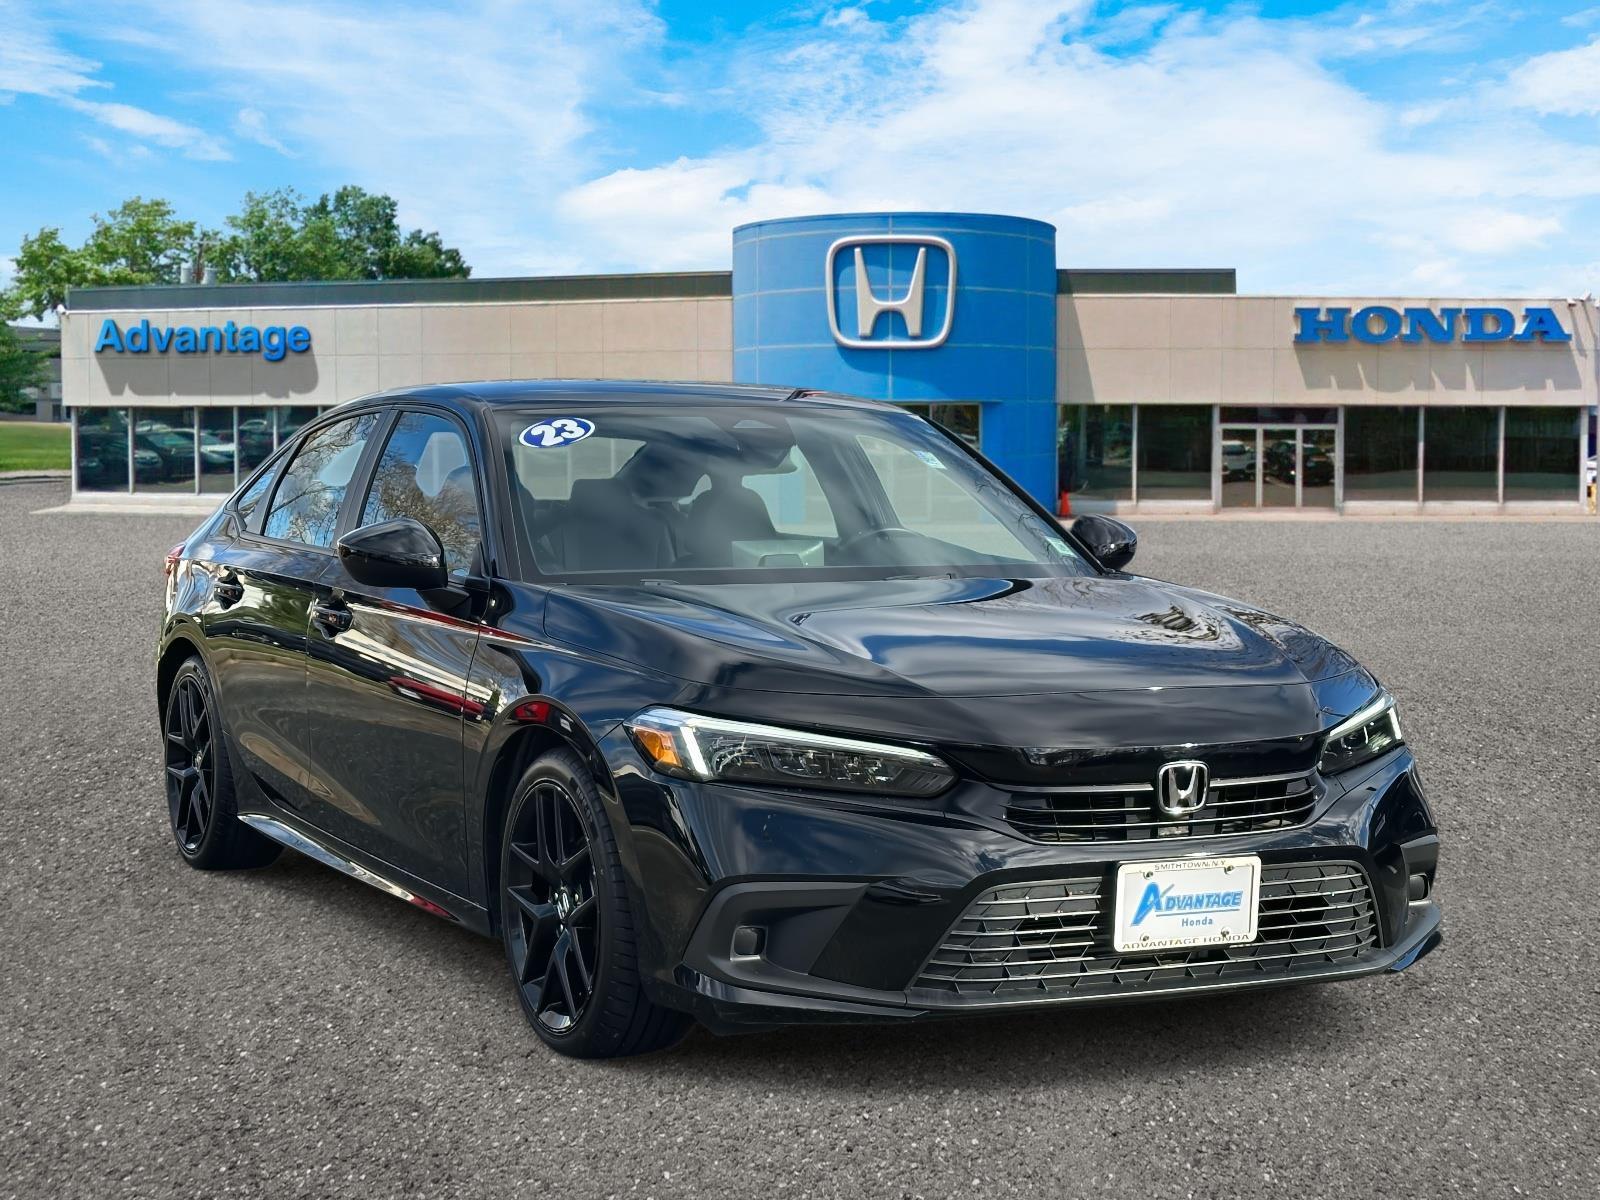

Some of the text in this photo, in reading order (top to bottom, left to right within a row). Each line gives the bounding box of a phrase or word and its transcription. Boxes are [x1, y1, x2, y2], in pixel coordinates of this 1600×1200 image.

[94, 318, 312, 362] Advantage
[1294, 306, 1573, 344] HONDA
[530, 418, 586, 447] 23
[1130, 882, 1244, 927] ADVANTAGE
[1181, 916, 1214, 927] Honda
[1121, 934, 1250, 950] ADVANTAGE HONDA
